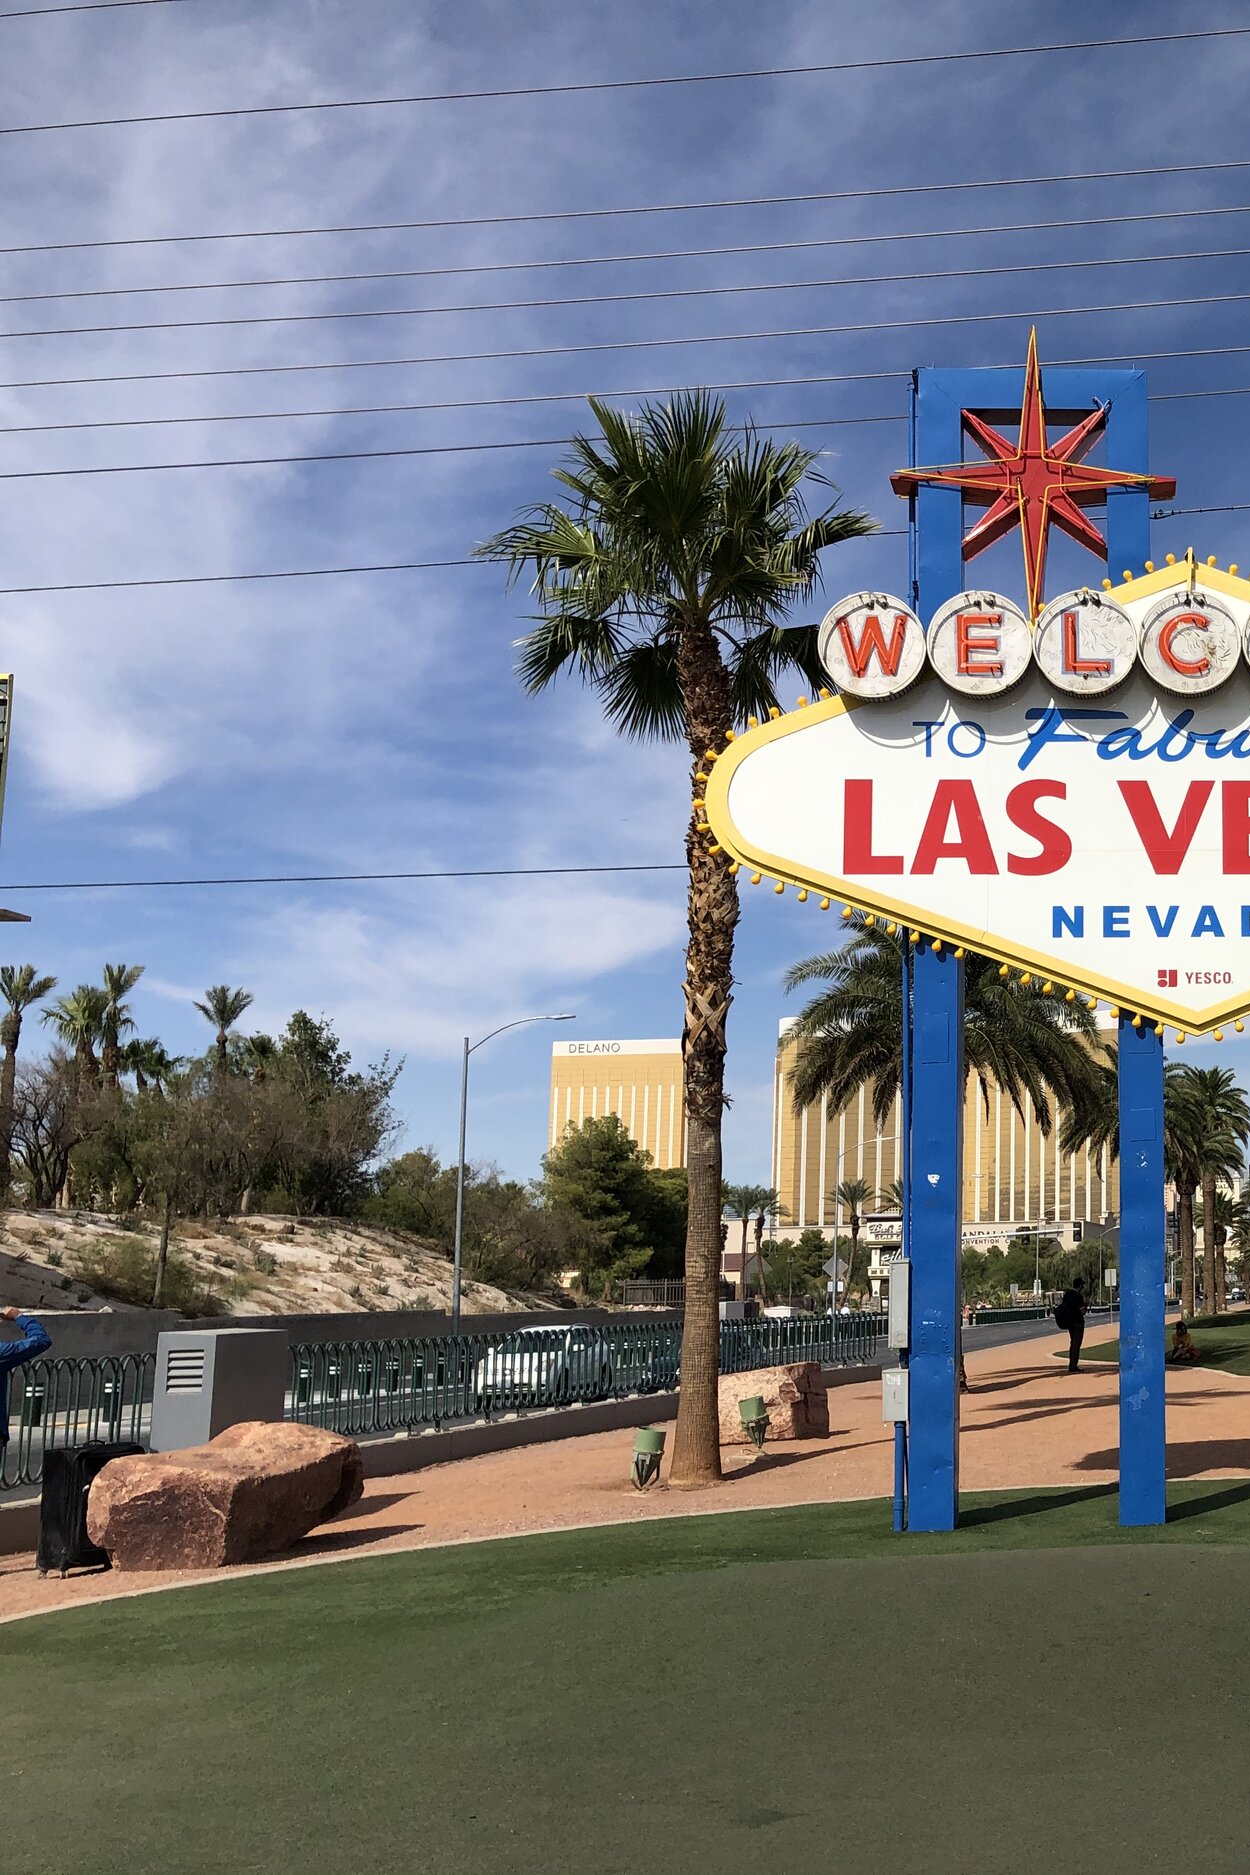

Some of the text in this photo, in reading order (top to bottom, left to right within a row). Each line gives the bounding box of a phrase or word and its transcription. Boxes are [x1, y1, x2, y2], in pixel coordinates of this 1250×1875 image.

[913, 720, 985, 757] TO
[843, 778, 1073, 875] LAS
[1185, 972, 1232, 984] YESCO
[569, 1043, 621, 1054] DELANO
